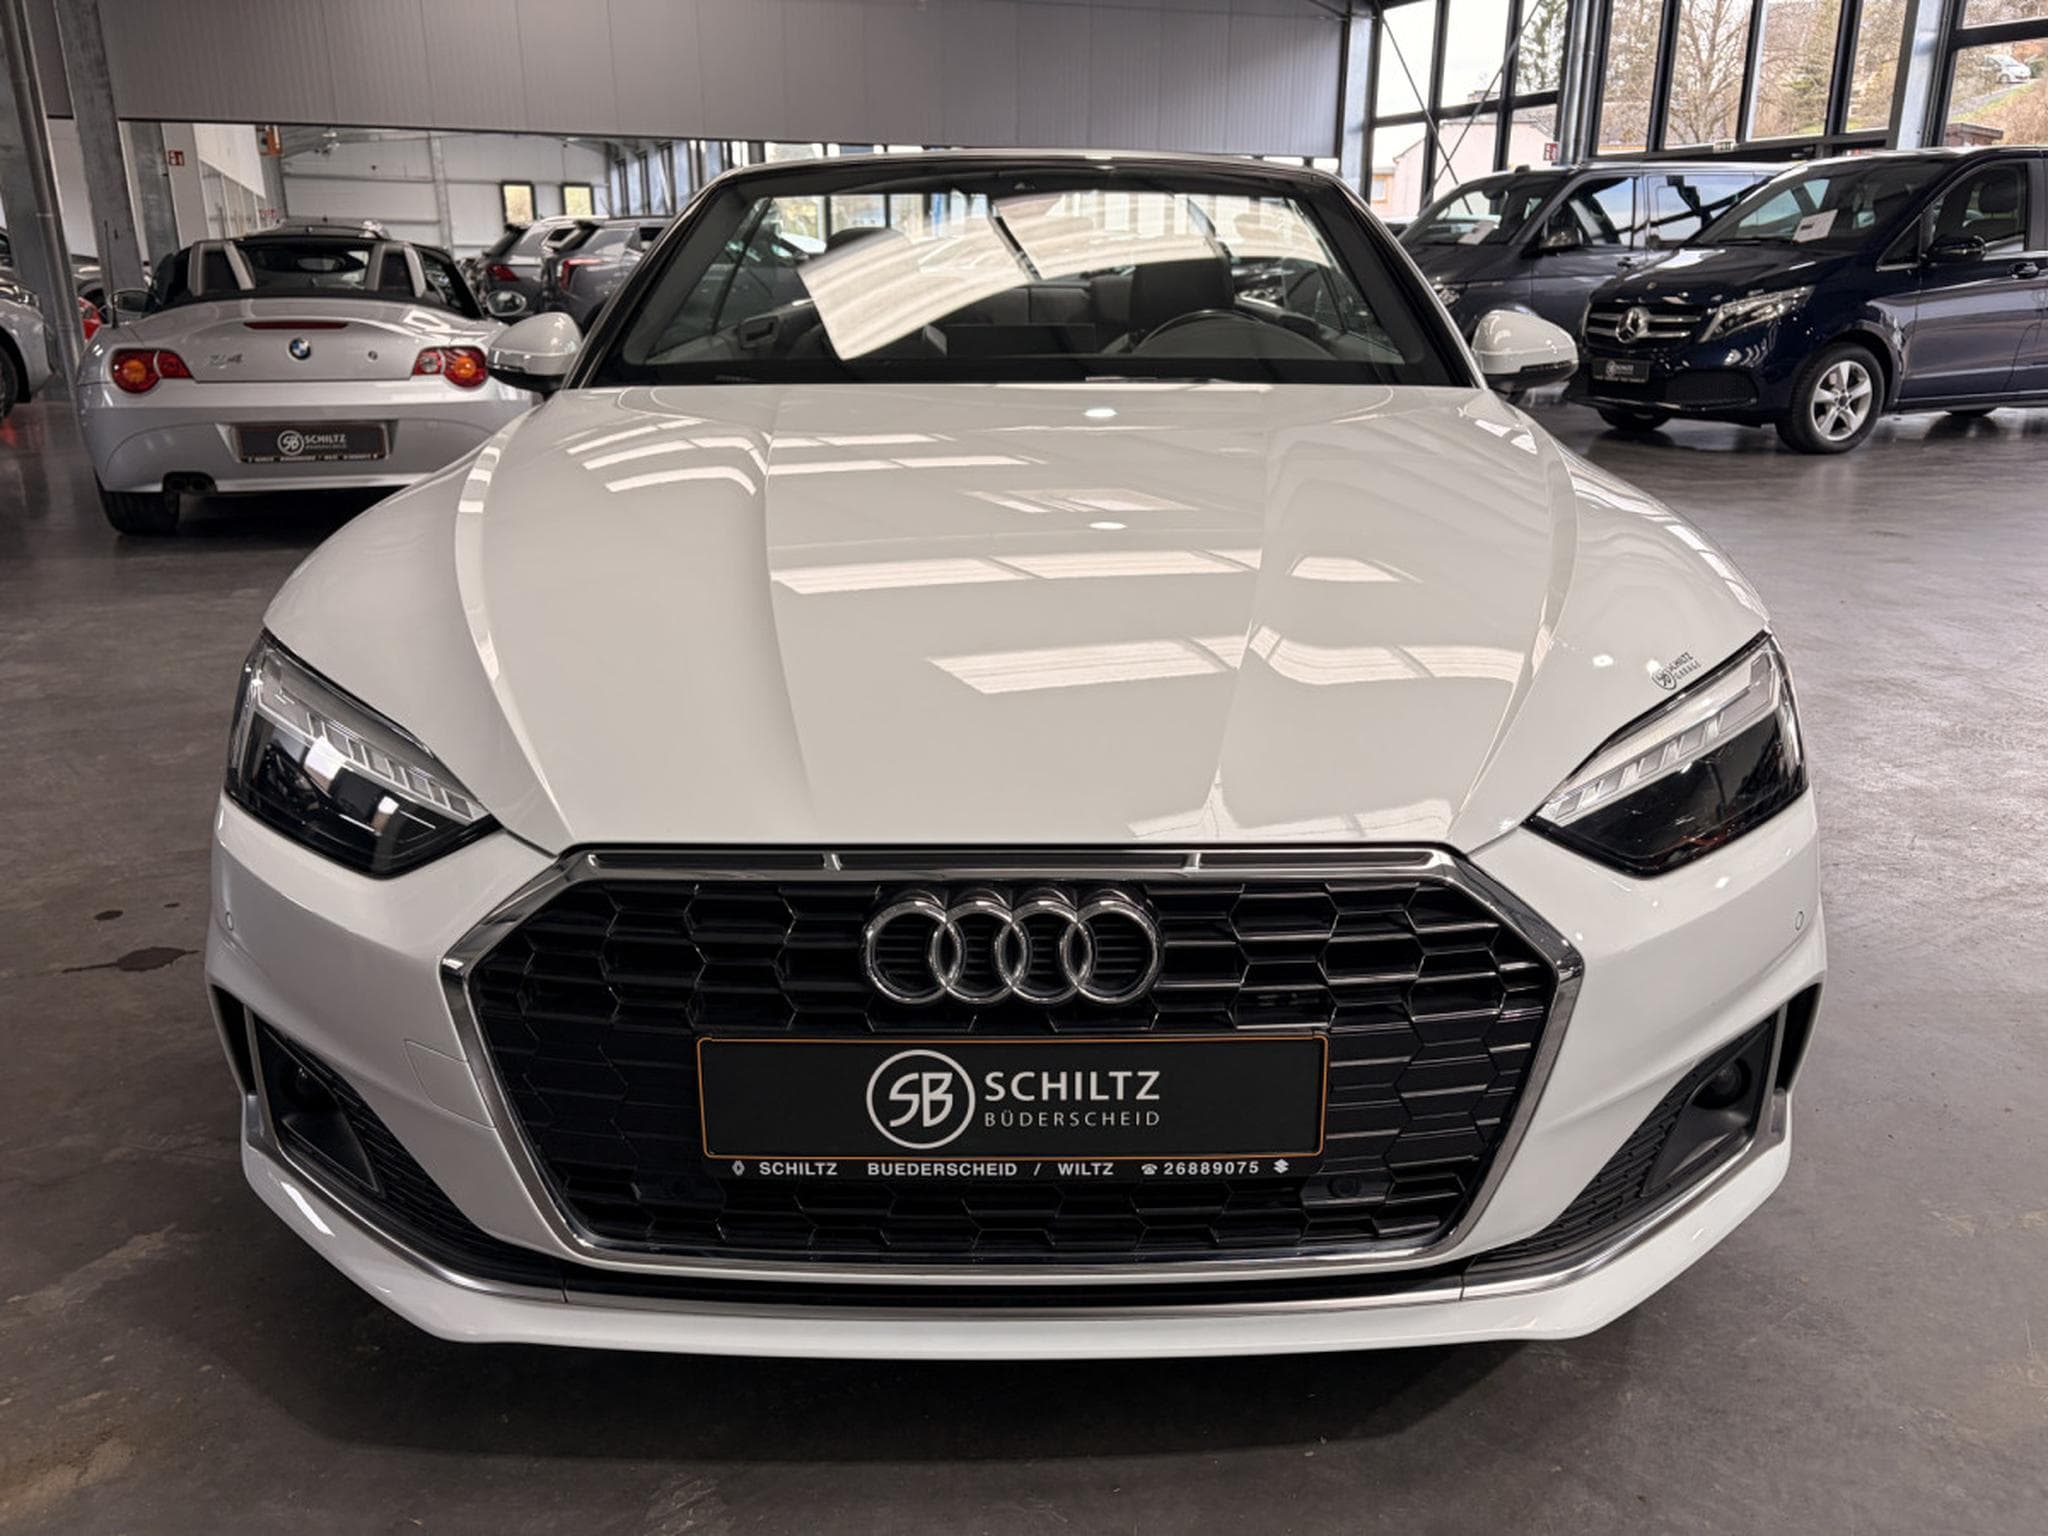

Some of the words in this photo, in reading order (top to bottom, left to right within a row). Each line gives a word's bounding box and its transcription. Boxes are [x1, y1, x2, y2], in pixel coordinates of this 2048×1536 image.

[305, 434, 347, 444] SCHILTZ
[984, 1070, 1161, 1101] SCHILTZ
[888, 1072, 954, 1128] SB
[984, 1109, 1161, 1128] BÜDERSCHEID
[759, 1161, 839, 1176] SCHILTZ
[867, 1162, 1018, 1177] BUEDERSCHEID
[1057, 1162, 1115, 1177] WILTZ
[1163, 1160, 1260, 1176] 26889075
